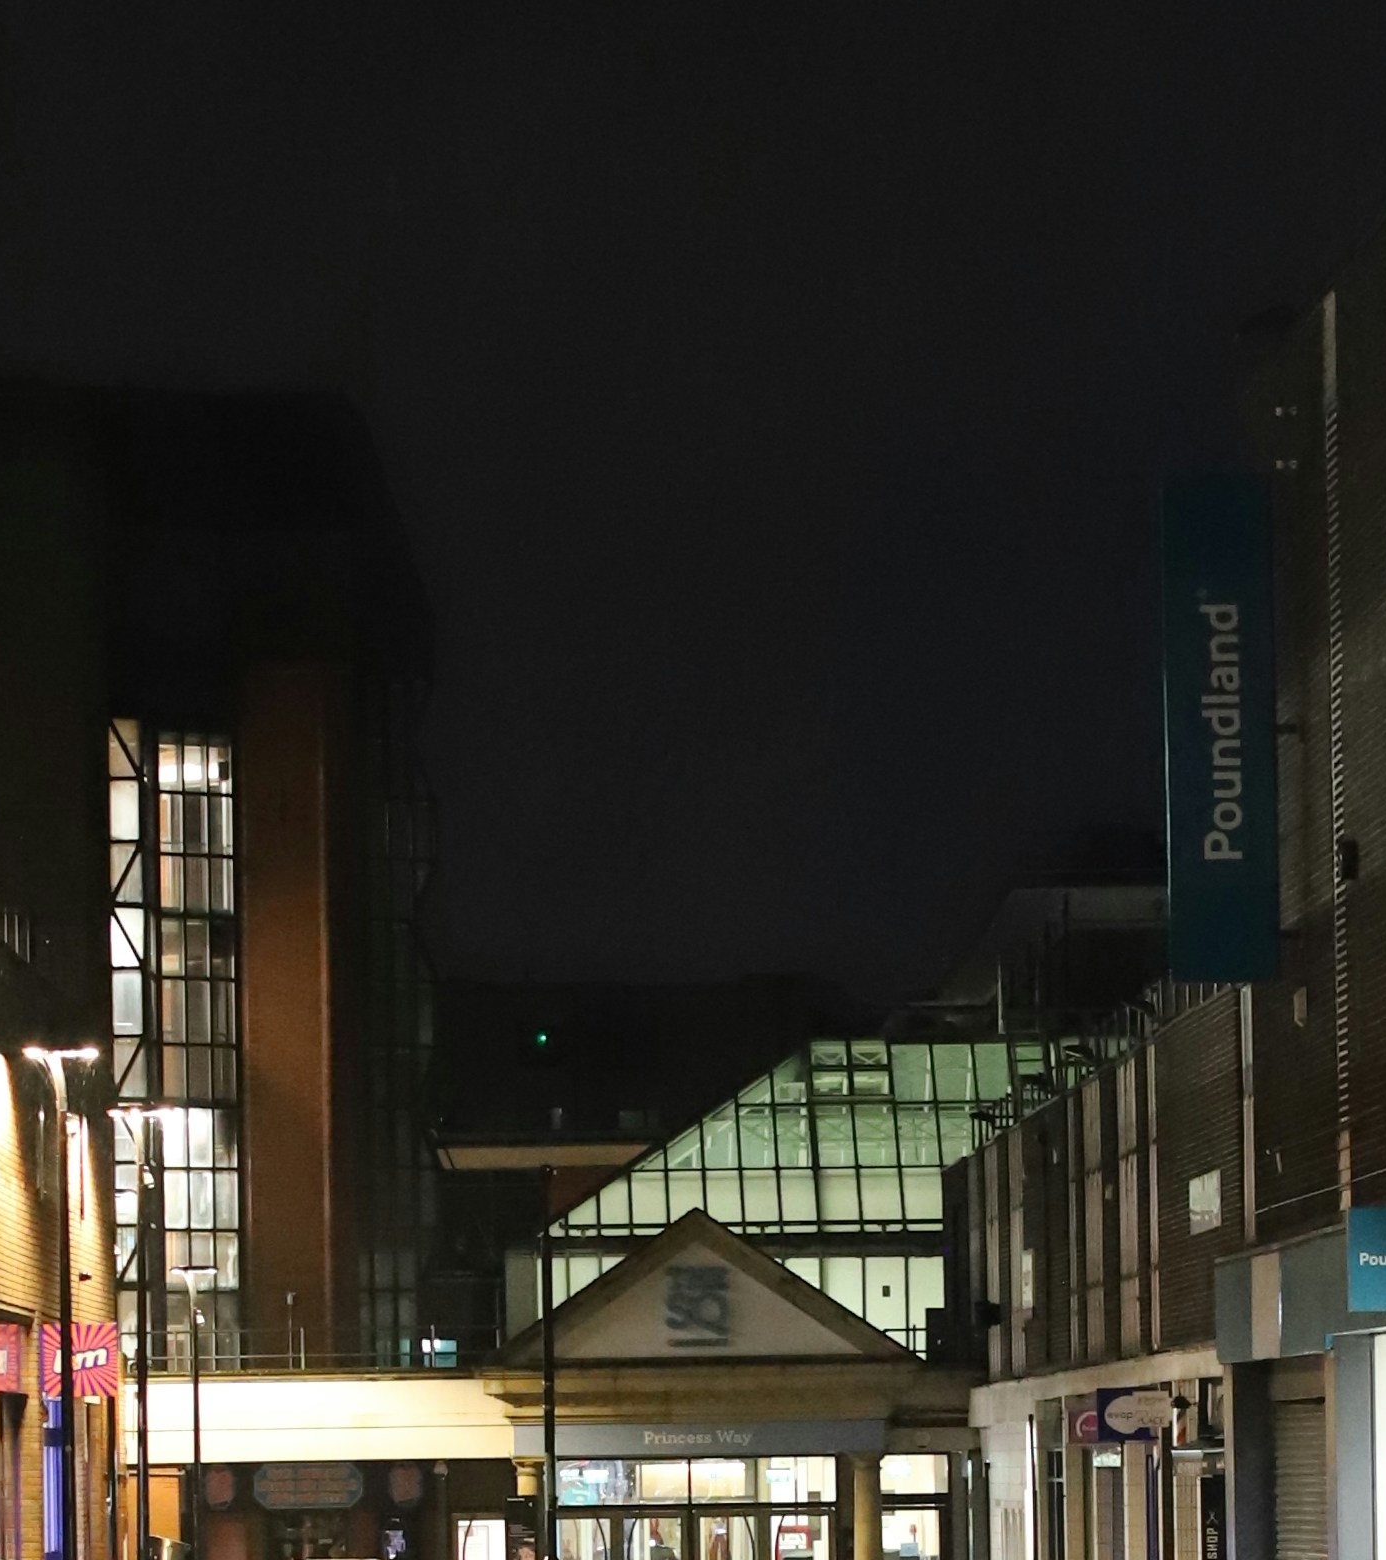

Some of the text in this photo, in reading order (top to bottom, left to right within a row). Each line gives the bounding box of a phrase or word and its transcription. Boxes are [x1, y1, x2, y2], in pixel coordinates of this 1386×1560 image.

[1199, 603, 1243, 861] Poundland
[644, 1430, 753, 1446] Princess Way
